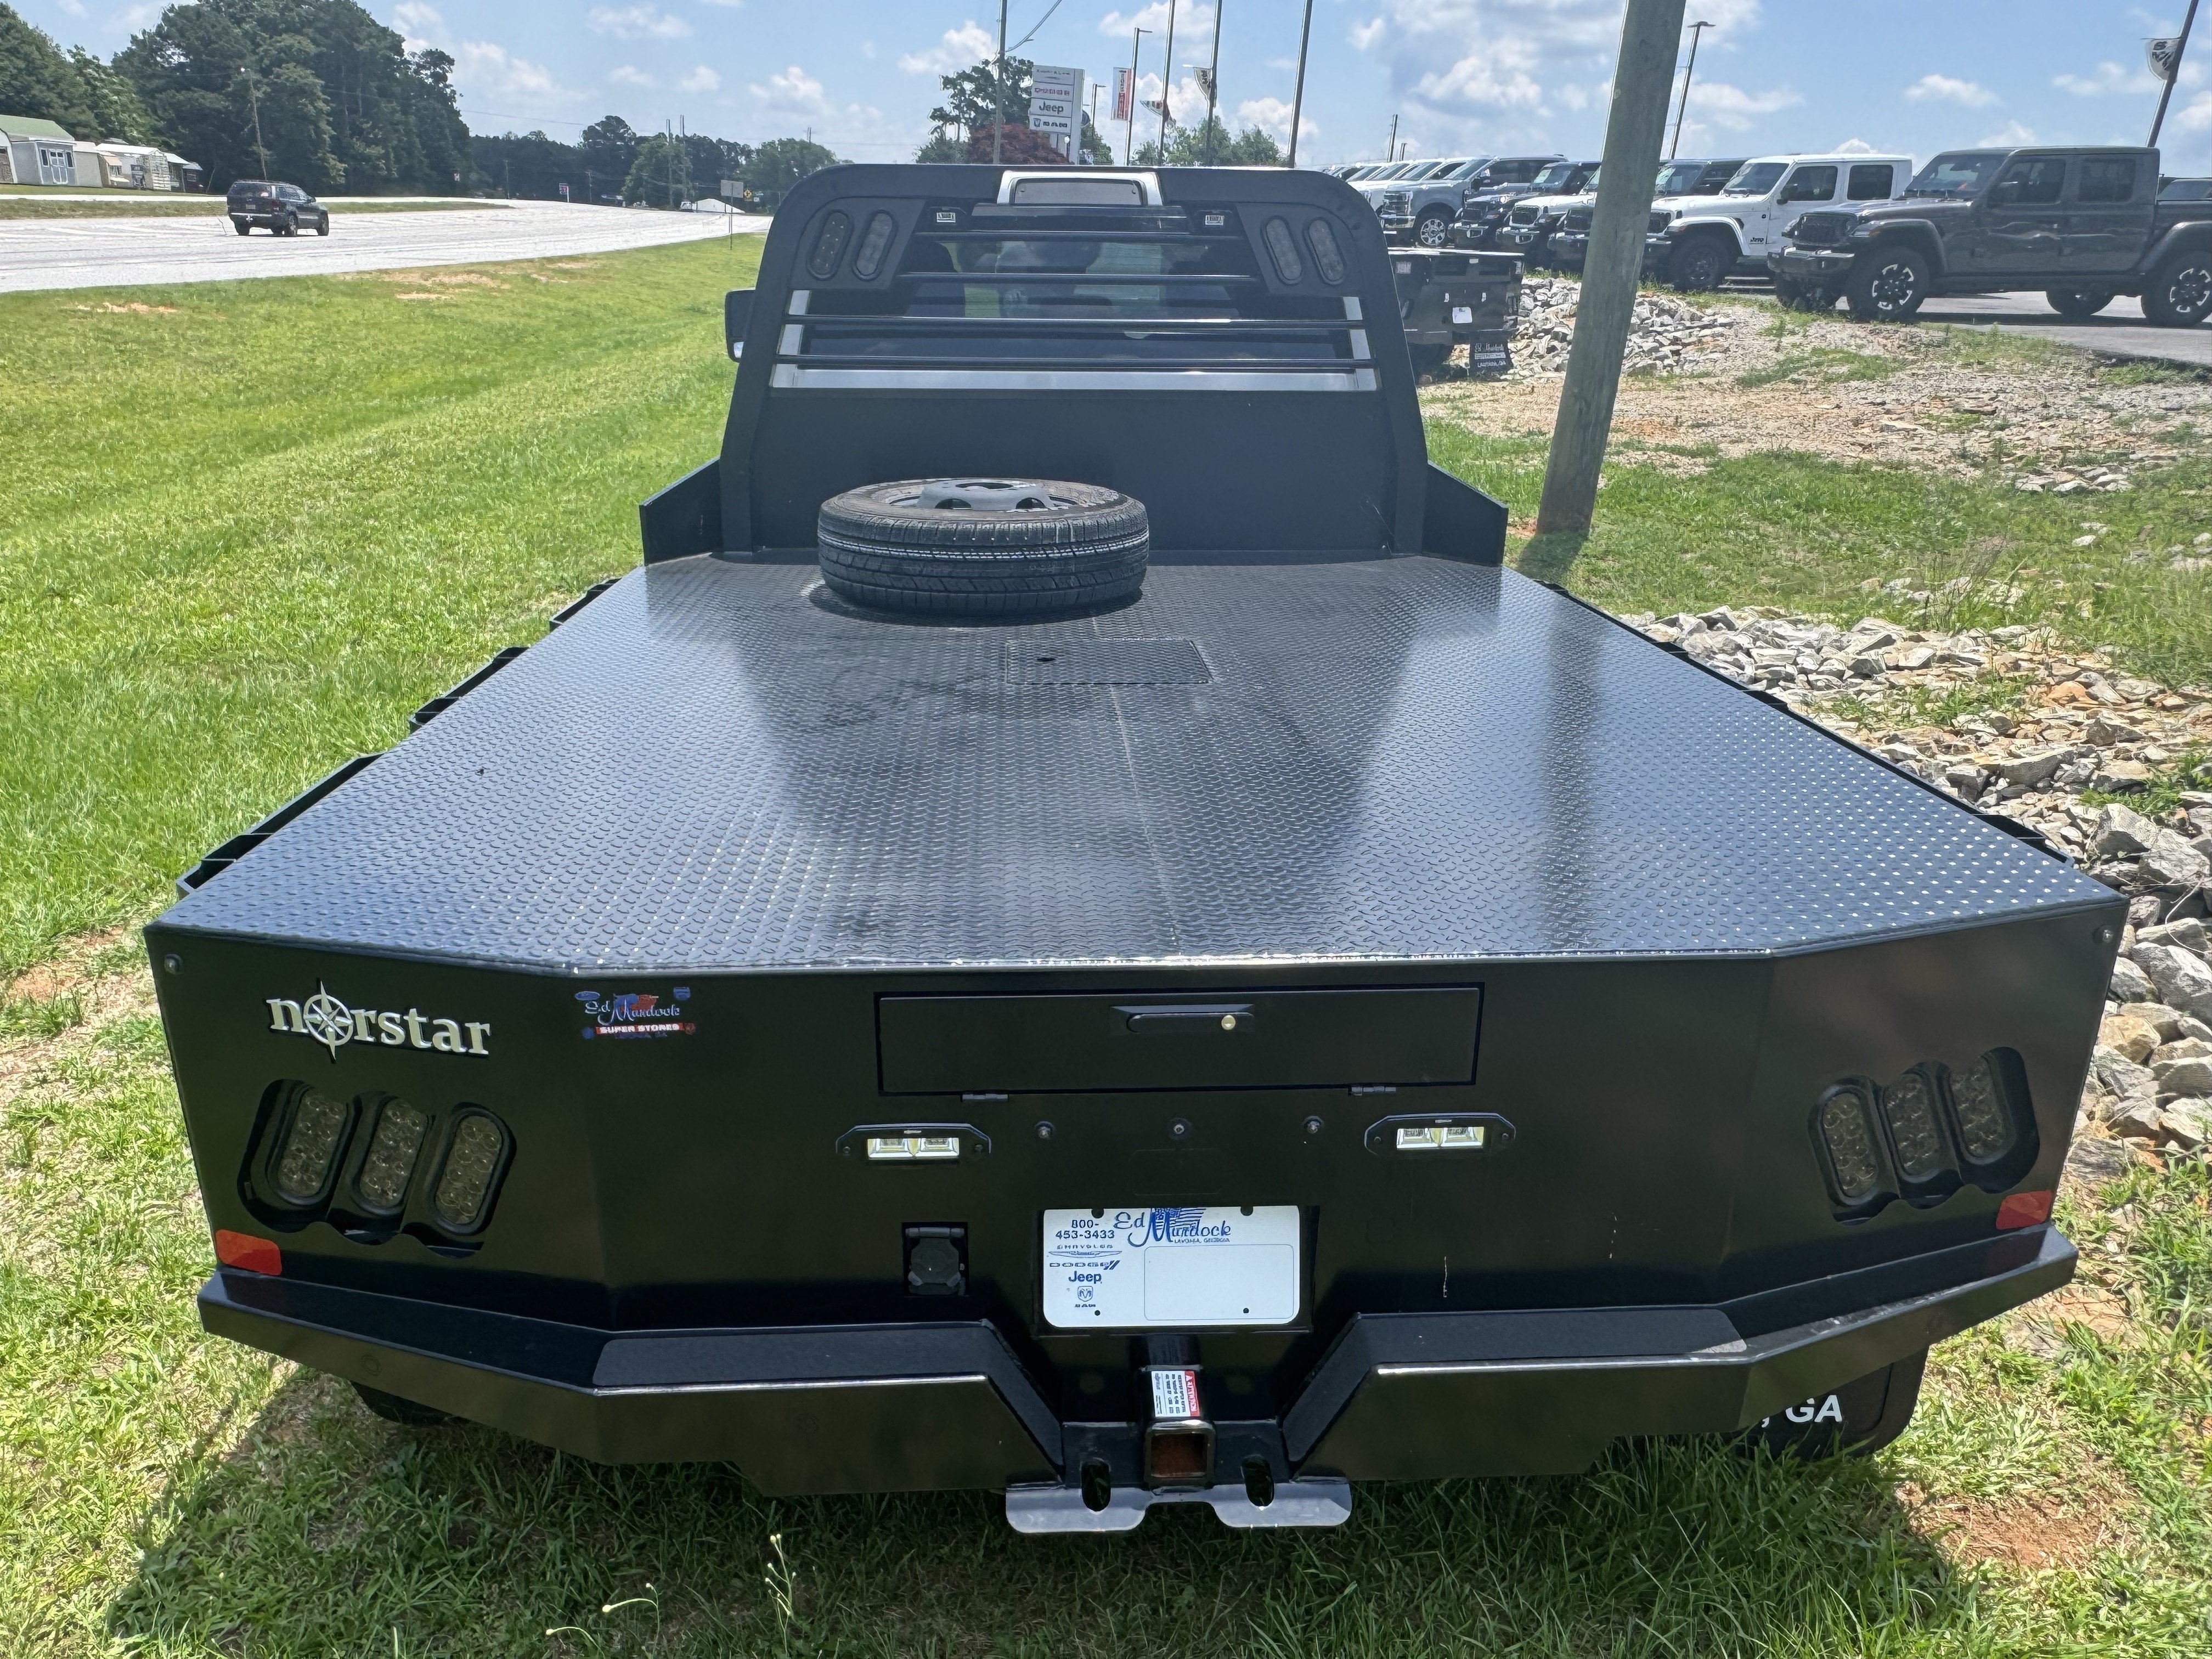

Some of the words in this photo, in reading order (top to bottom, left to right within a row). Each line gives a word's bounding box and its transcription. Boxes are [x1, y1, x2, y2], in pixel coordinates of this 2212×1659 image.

[1039, 101, 1064, 115] Jeep
[1071, 1220, 1099, 1228] 800-
[1113, 1212, 1146, 1229] Ed
[1056, 1230, 1115, 1239] 453-3433
[1127, 1208, 1231, 1248] Murdock
[1068, 1271, 1102, 1284] Jeep
[1785, 1395, 1843, 1423] GA
